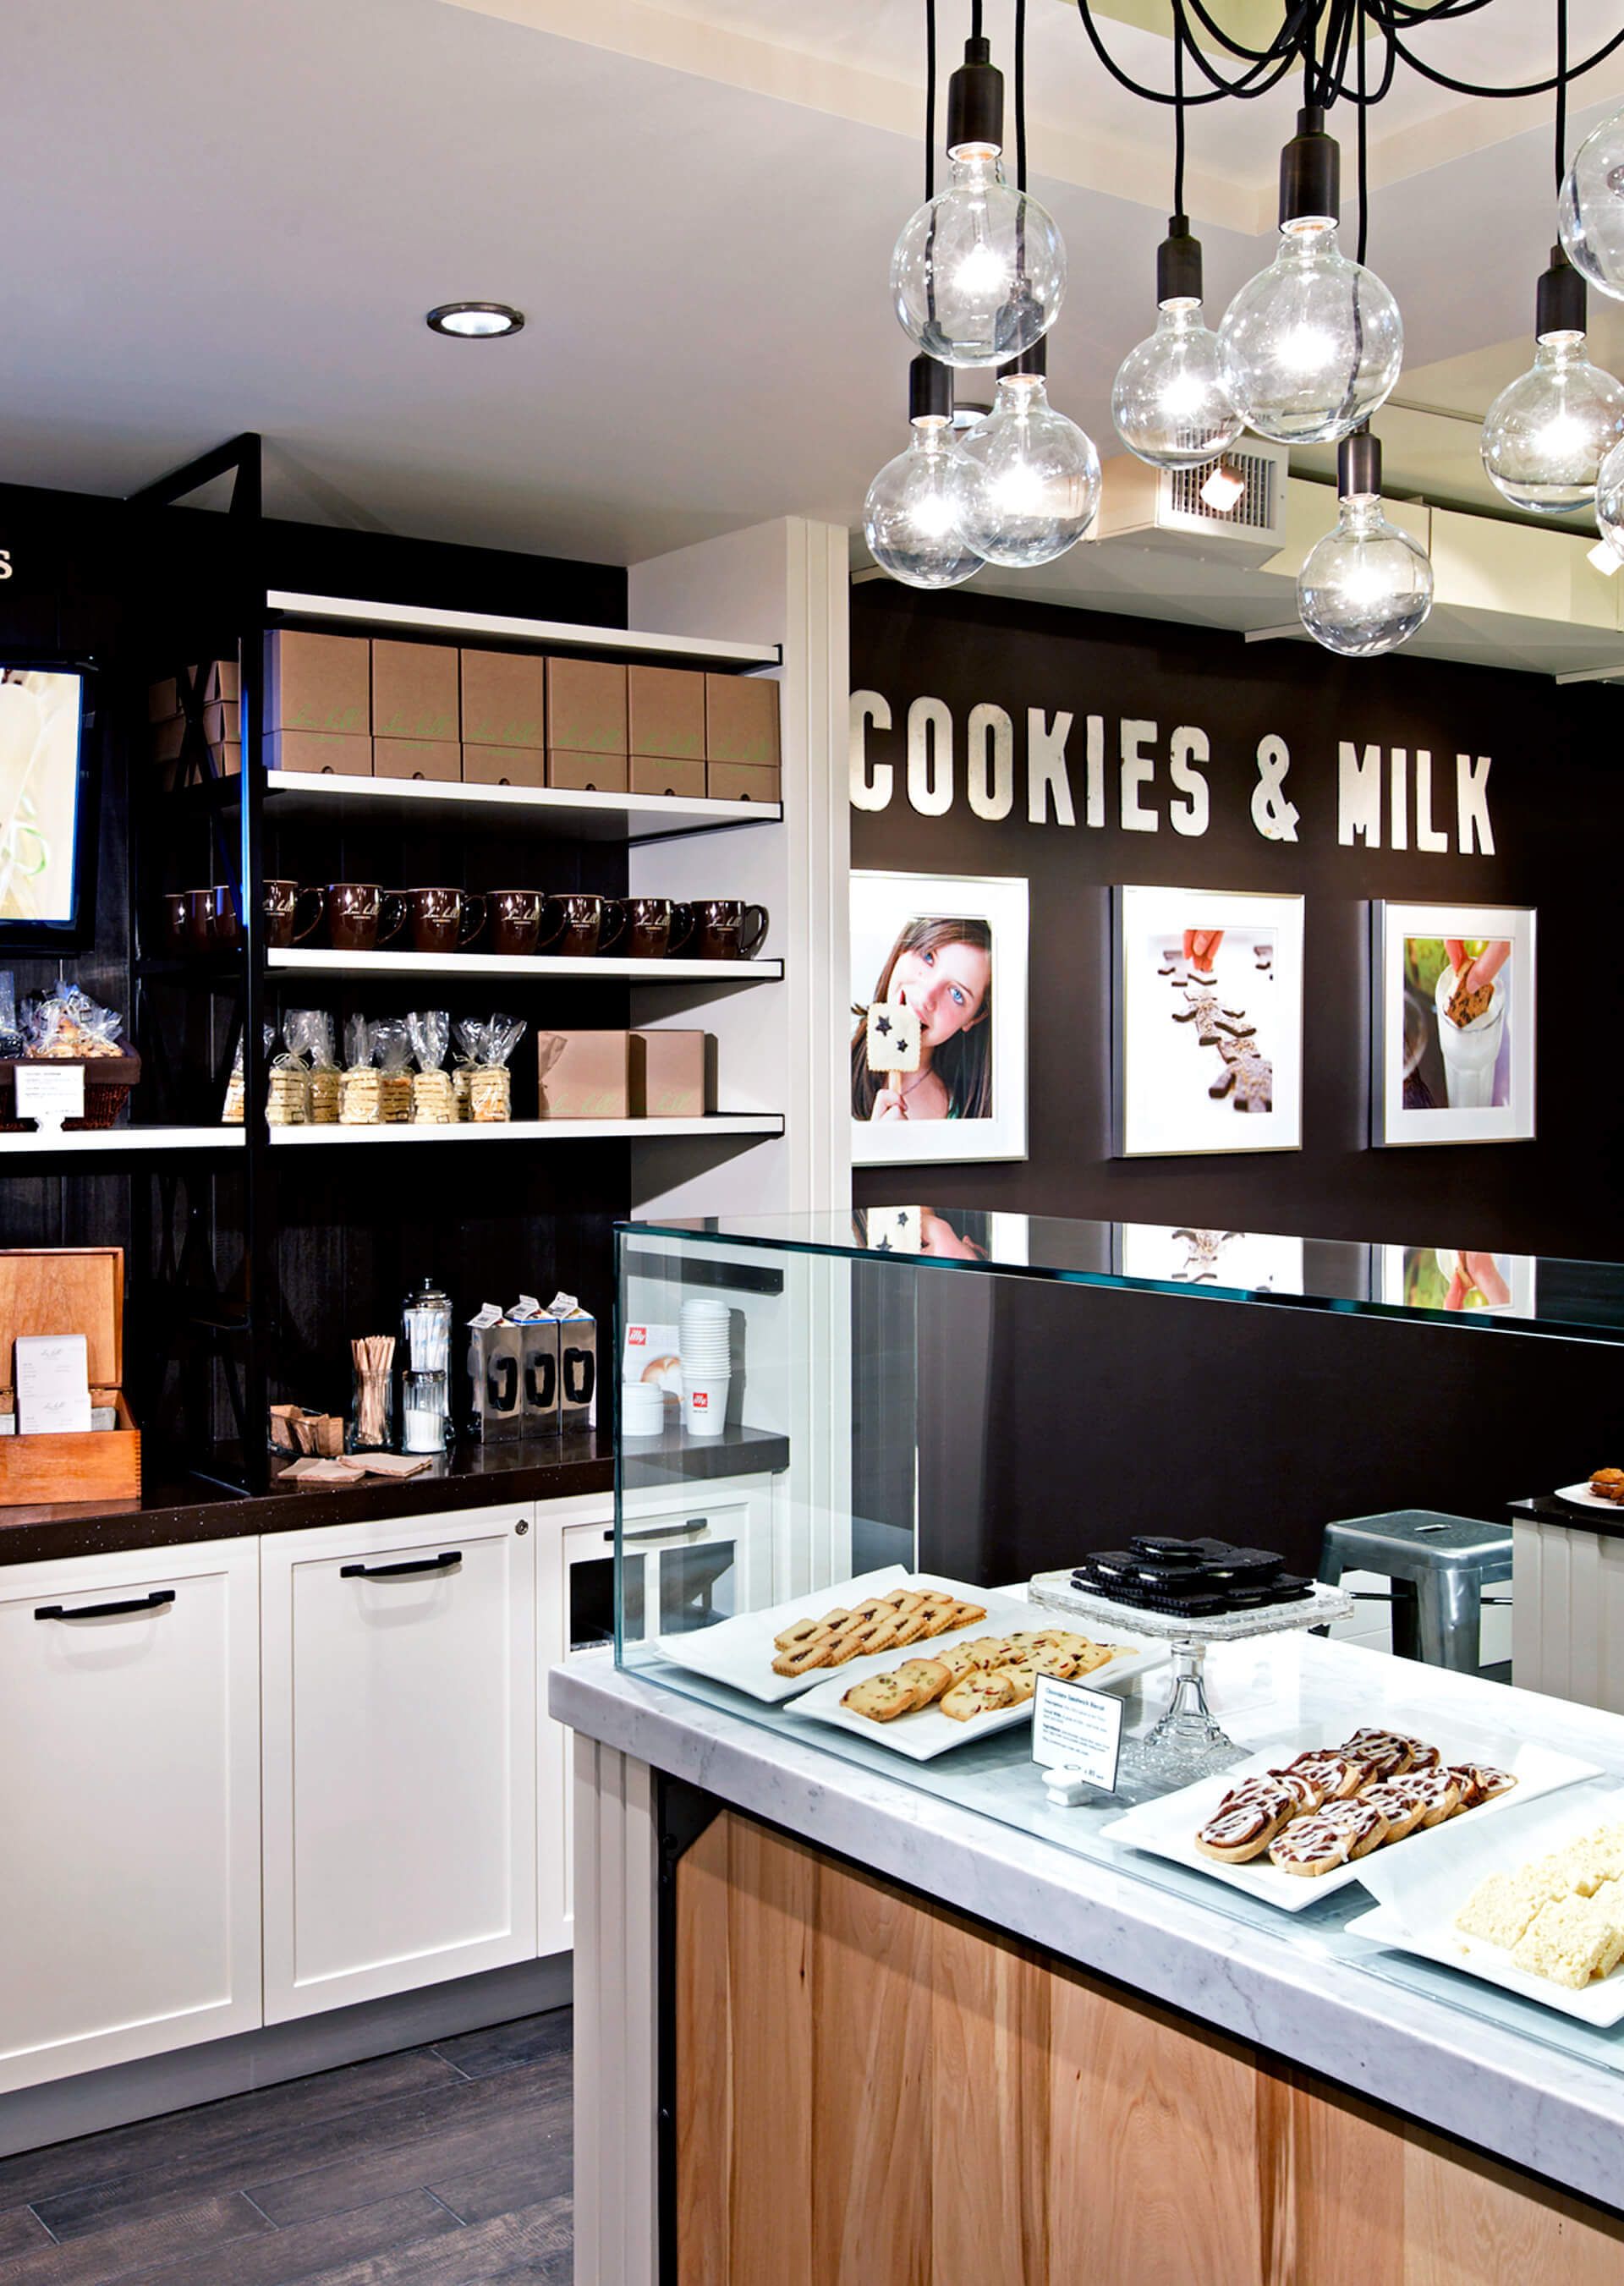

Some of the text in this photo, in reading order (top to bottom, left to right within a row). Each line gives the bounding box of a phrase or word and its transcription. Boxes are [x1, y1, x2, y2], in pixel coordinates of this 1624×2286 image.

[849, 689, 1495, 856] COOKIES & MILK
